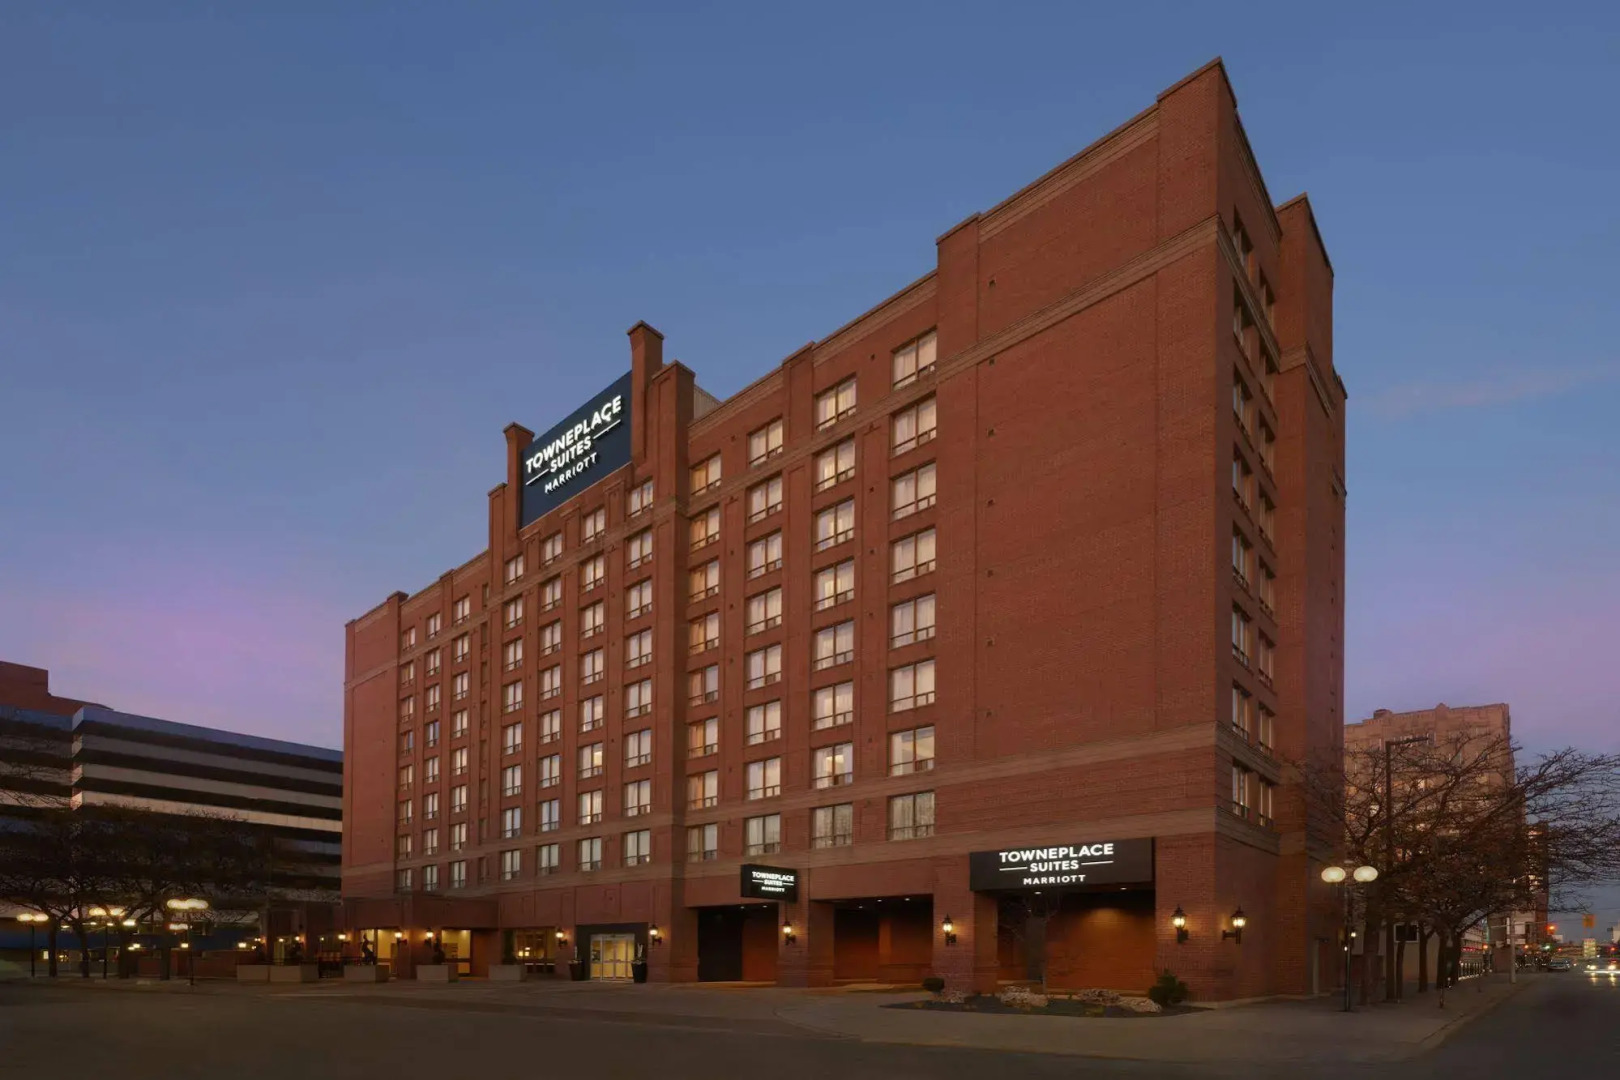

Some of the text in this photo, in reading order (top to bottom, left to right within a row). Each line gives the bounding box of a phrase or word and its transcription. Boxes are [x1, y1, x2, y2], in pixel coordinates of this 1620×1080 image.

[526, 395, 622, 473] TOWNEPLACE
[550, 436, 592, 473] SUITES
[544, 452, 597, 494] MARRIOTT
[999, 843, 1114, 863] TOWNEPLACE
[1030, 860, 1079, 872] SUITES
[752, 871, 794, 882] TOWNEPLACE
[1023, 874, 1086, 885] MARRIOTT
